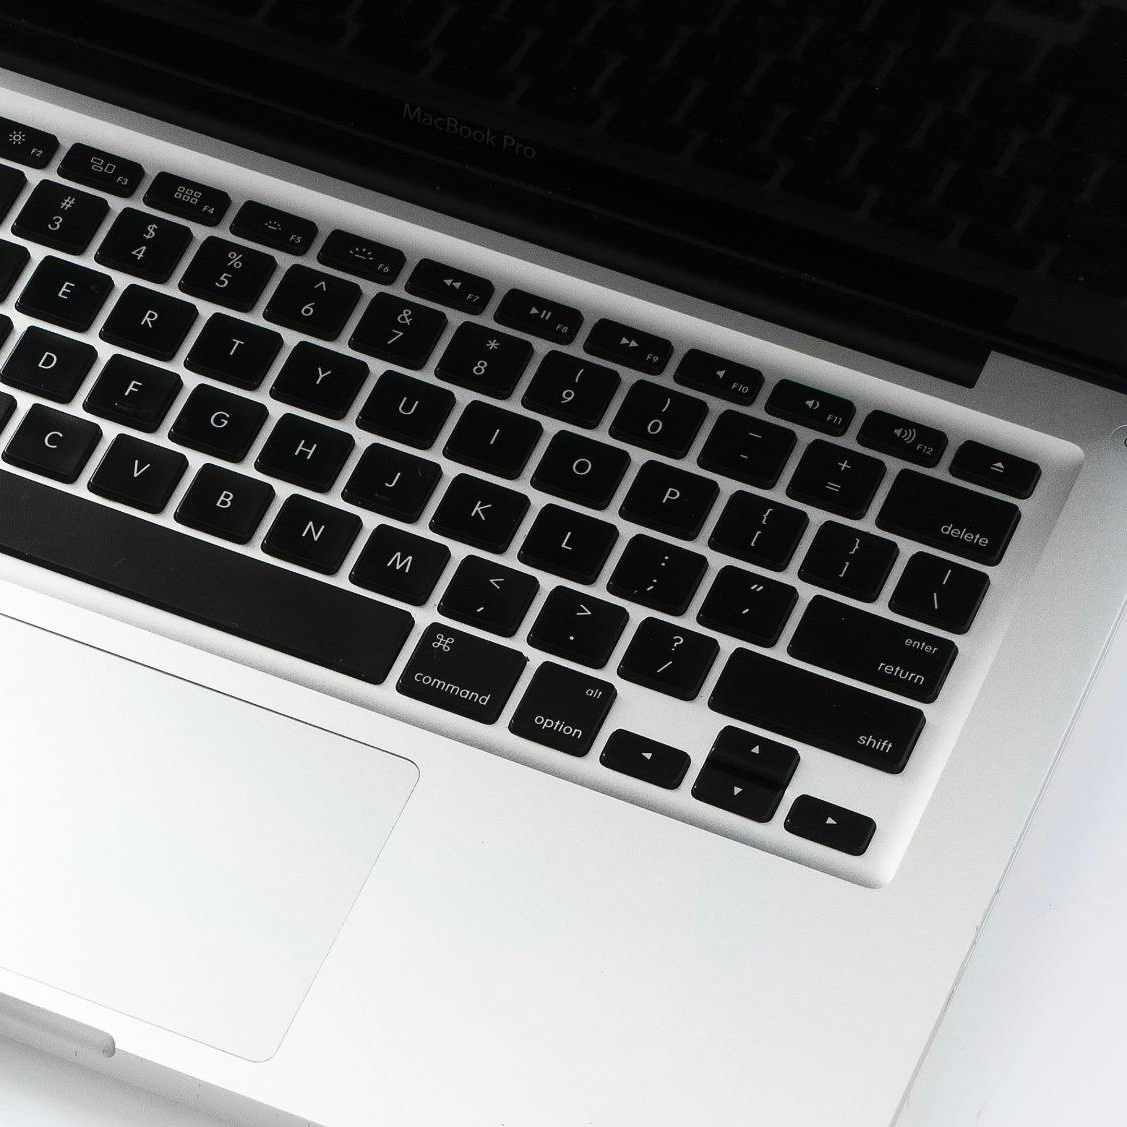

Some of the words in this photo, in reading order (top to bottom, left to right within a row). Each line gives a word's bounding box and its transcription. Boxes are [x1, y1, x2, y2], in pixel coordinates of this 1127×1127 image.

[402, 103, 497, 147] MacBook
[503, 135, 538, 160] Pro
[30, 147, 43, 158] F2
[116, 176, 129, 186] F3
[60, 196, 76, 211] #
[202, 205, 215, 214] F4
[47, 215, 63, 231] 3
[142, 223, 158, 240] $
[289, 234, 302, 244] F5
[131, 245, 147, 261] 4
[227, 251, 243, 269] %
[377, 263, 389, 273] F6
[215, 272, 232, 288] 5
[57, 281, 76, 299] E
[466, 293, 480, 303] F7
[300, 302, 315, 317] 6
[397, 309, 413, 326] &
[140, 310, 159, 329] R
[555, 323, 569, 334] F8
[386, 329, 404, 345] 7
[229, 338, 245, 356] T
[37, 351, 58, 370] D
[645, 353, 659, 363] F9
[315, 367, 332, 385] Y
[472, 360, 488, 376] 8
[575, 368, 584, 383] (
[124, 380, 143, 396] F
[731, 382, 749, 394] F10
[560, 389, 575, 404] 9
[398, 396, 419, 415] U
[661, 397, 671, 413] )
[210, 411, 230, 428] G
[647, 419, 663, 435] 0
[826, 414, 843, 425] F11
[44, 431, 63, 449] C
[489, 428, 500, 445] I
[294, 439, 317, 460] H
[916, 443, 934, 456] F12
[133, 459, 151, 478] V
[572, 458, 592, 476] O
[837, 459, 851, 471] +
[384, 472, 401, 488] J
[825, 481, 842, 492] =
[215, 490, 234, 509] B
[662, 487, 680, 504] P
[471, 500, 492, 521] K
[761, 508, 774, 525] {
[301, 520, 325, 542] N
[750, 530, 762, 547] [
[940, 523, 989, 547] delete
[561, 531, 573, 551] L
[848, 537, 860, 555] }
[386, 551, 413, 573] M
[838, 561, 850, 578] ]
[489, 578, 505, 590] <
[646, 579, 657, 591] ;
[576, 604, 592, 616] >
[671, 635, 684, 651] ?
[904, 635, 941, 655] enter
[656, 660, 673, 673] /
[876, 661, 926, 687] return
[413, 670, 492, 707] command
[585, 688, 602, 699] alt
[534, 715, 583, 739] option
[857, 735, 893, 753] shift
